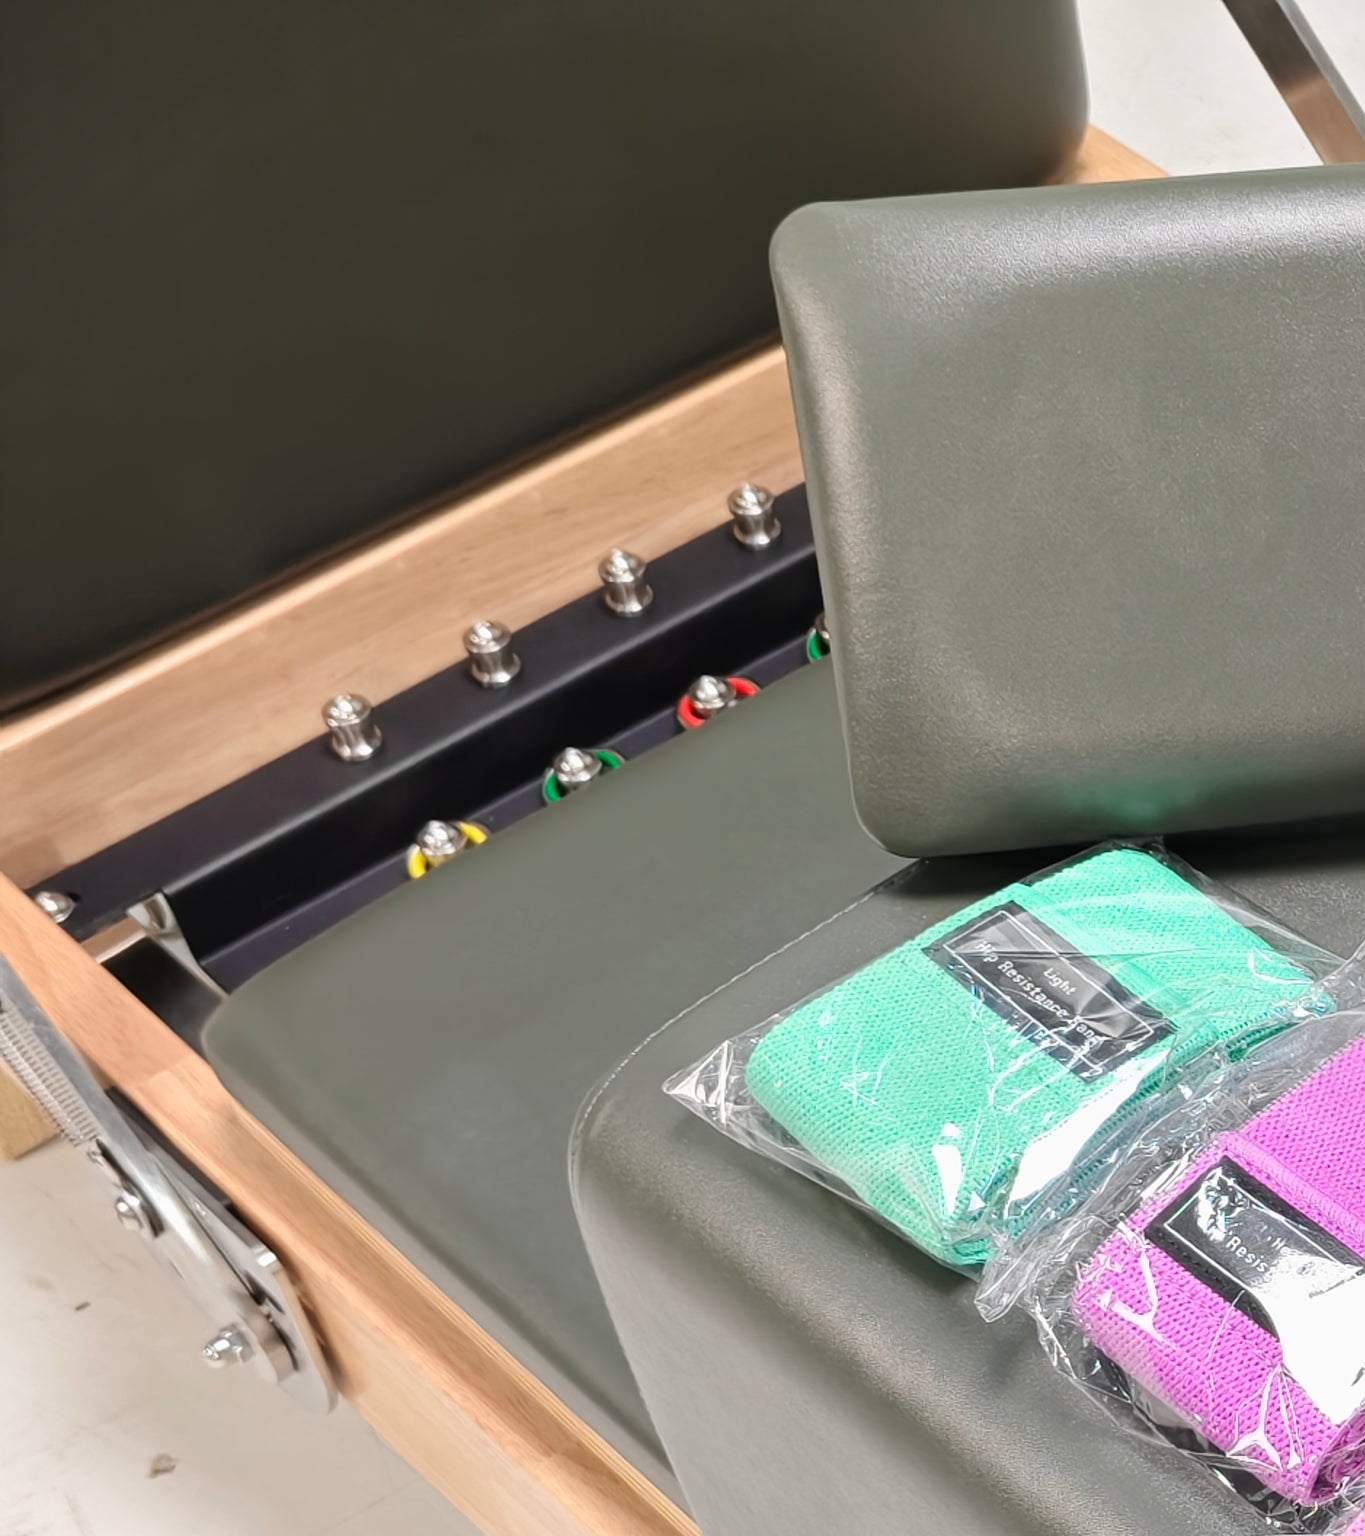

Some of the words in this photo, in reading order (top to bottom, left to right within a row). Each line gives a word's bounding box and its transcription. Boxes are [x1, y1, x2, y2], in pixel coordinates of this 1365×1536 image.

[975, 939, 999, 963] Hip
[998, 959, 1069, 1019] Resistance
[1043, 967, 1077, 996] Light
